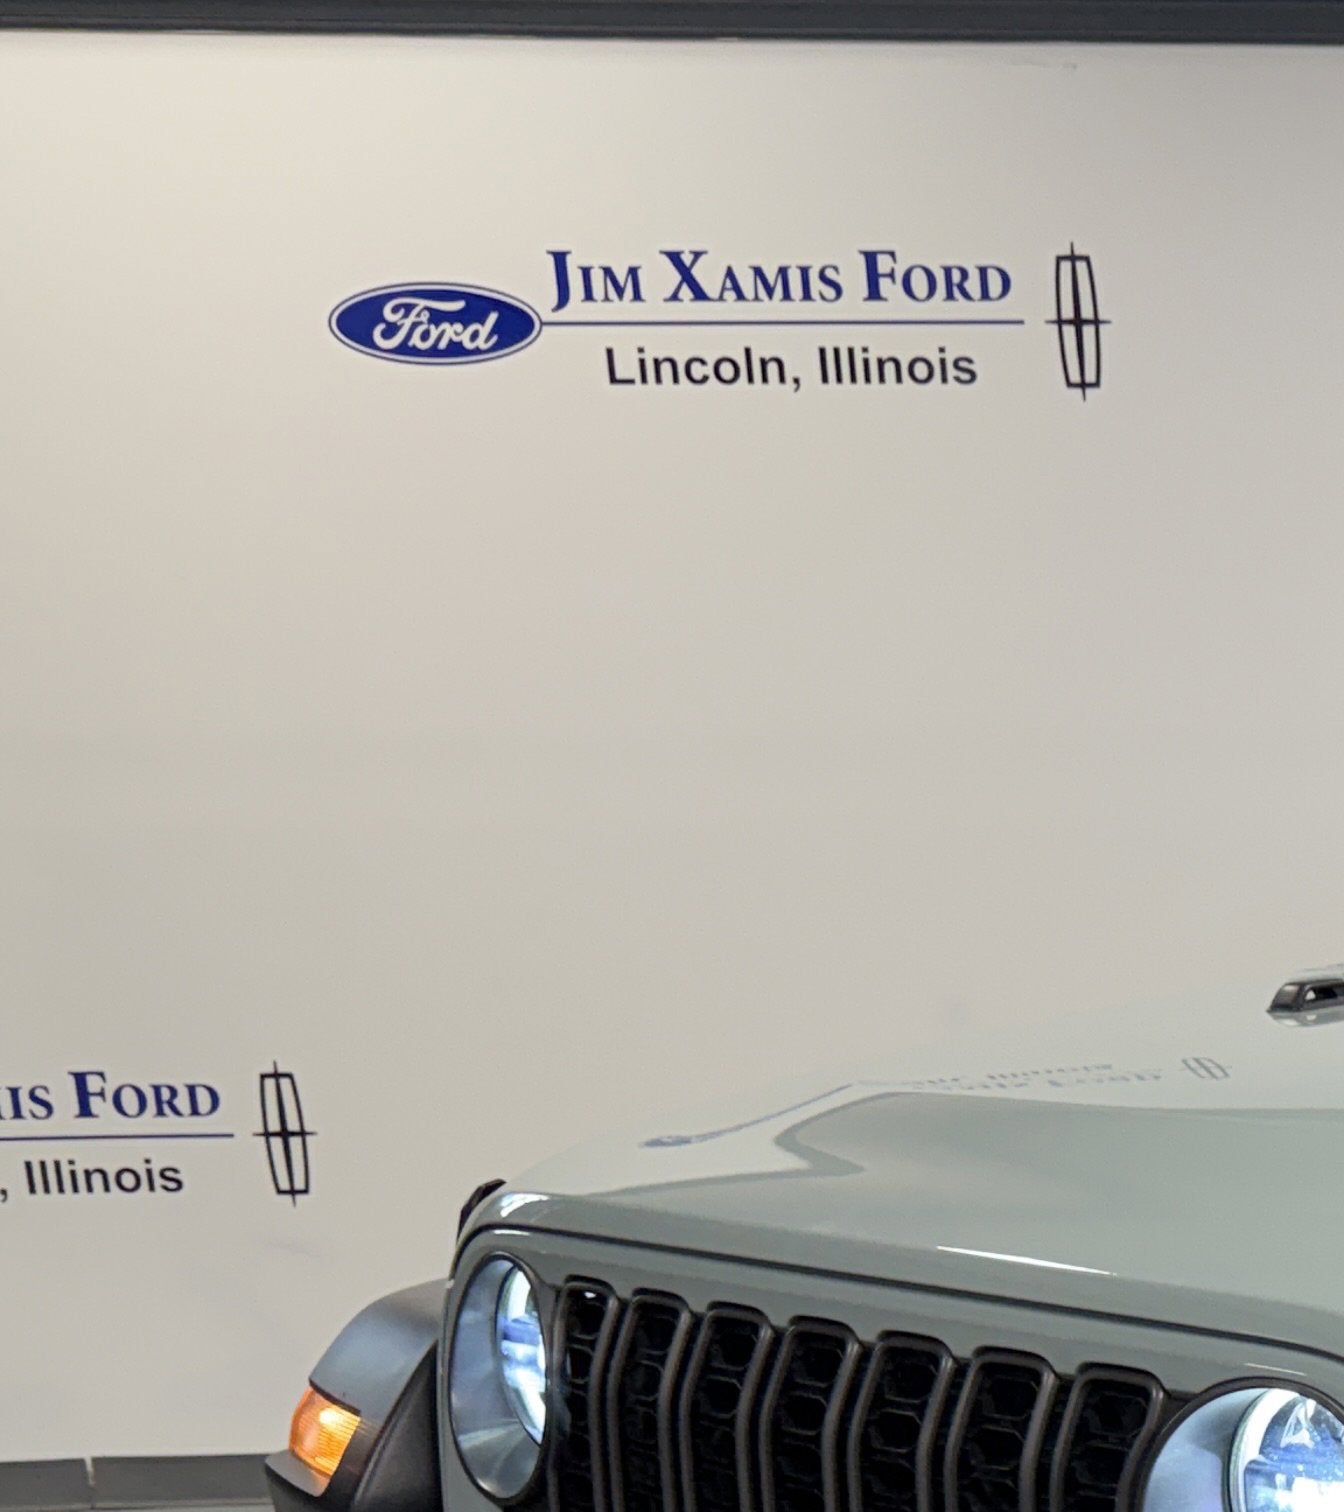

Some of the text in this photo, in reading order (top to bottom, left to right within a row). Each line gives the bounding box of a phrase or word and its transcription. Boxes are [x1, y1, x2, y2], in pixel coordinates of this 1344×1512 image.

[546, 249, 1012, 312] JIM XAMIS FORD
[373, 297, 499, 351] Ford
[605, 346, 978, 393] Lincoln, Illinois
[67, 1070, 221, 1119] FORD
[23, 1157, 184, 1195] Illinois
